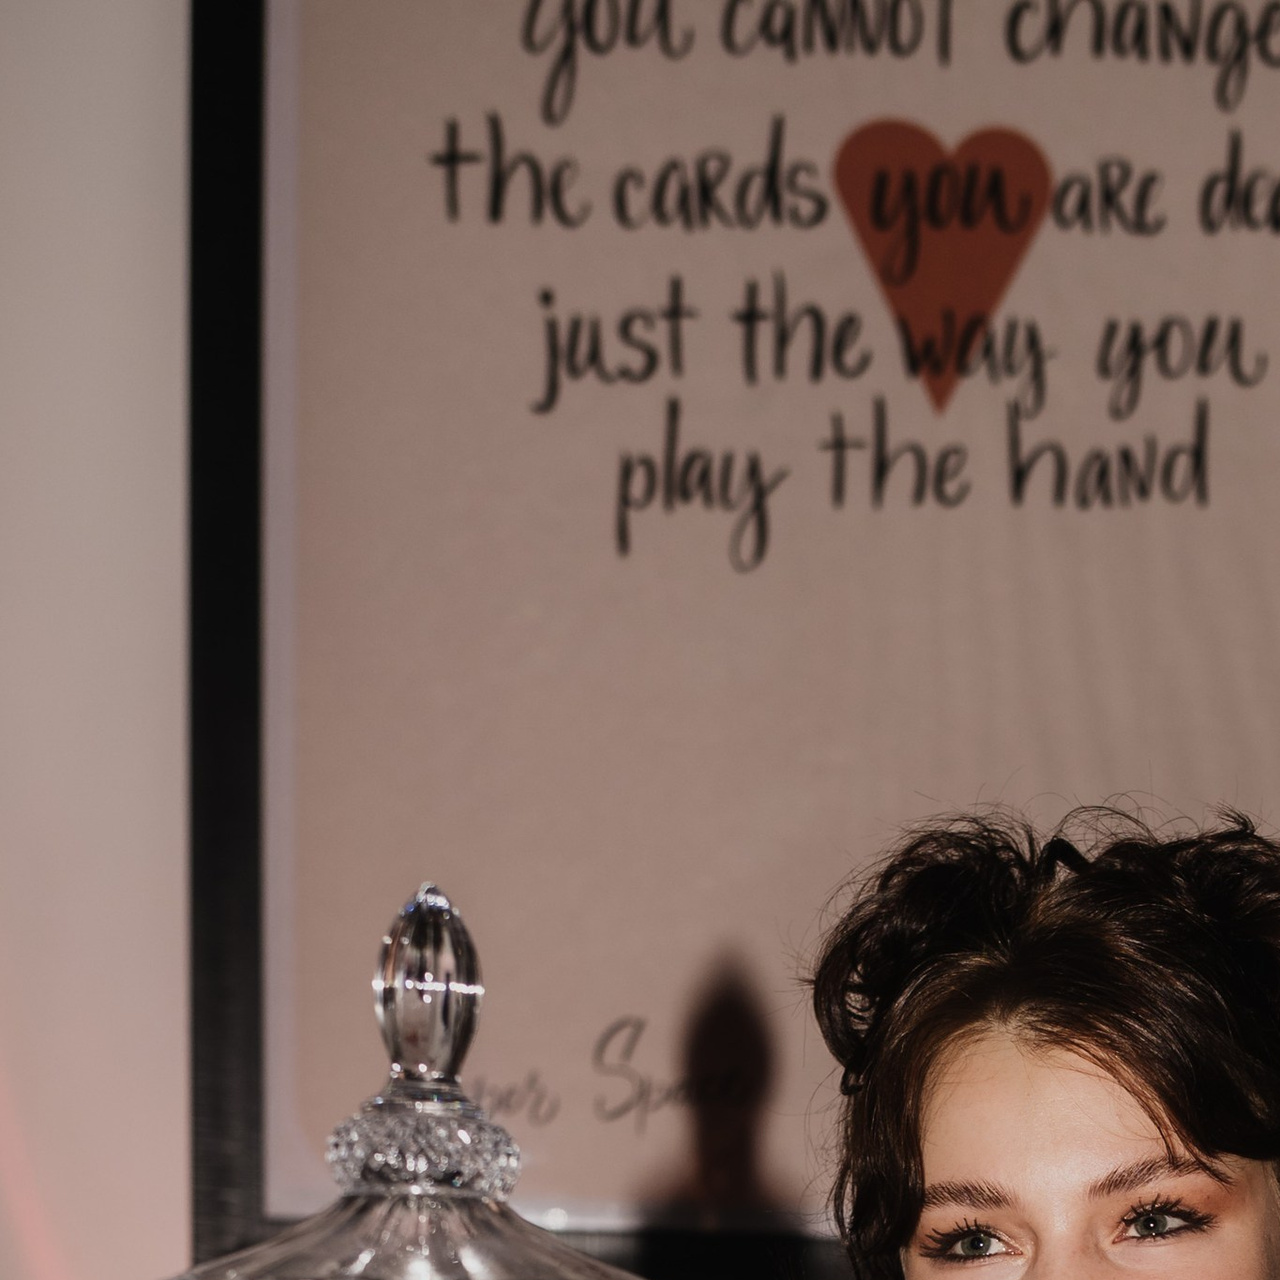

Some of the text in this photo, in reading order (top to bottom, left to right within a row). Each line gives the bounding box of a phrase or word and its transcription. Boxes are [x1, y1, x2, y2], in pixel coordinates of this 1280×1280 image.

[426, 110, 592, 230] the
[866, 156, 1034, 288] you
[531, 274, 1270, 422] just the way you
[614, 394, 789, 575] play
[818, 394, 972, 509] the
